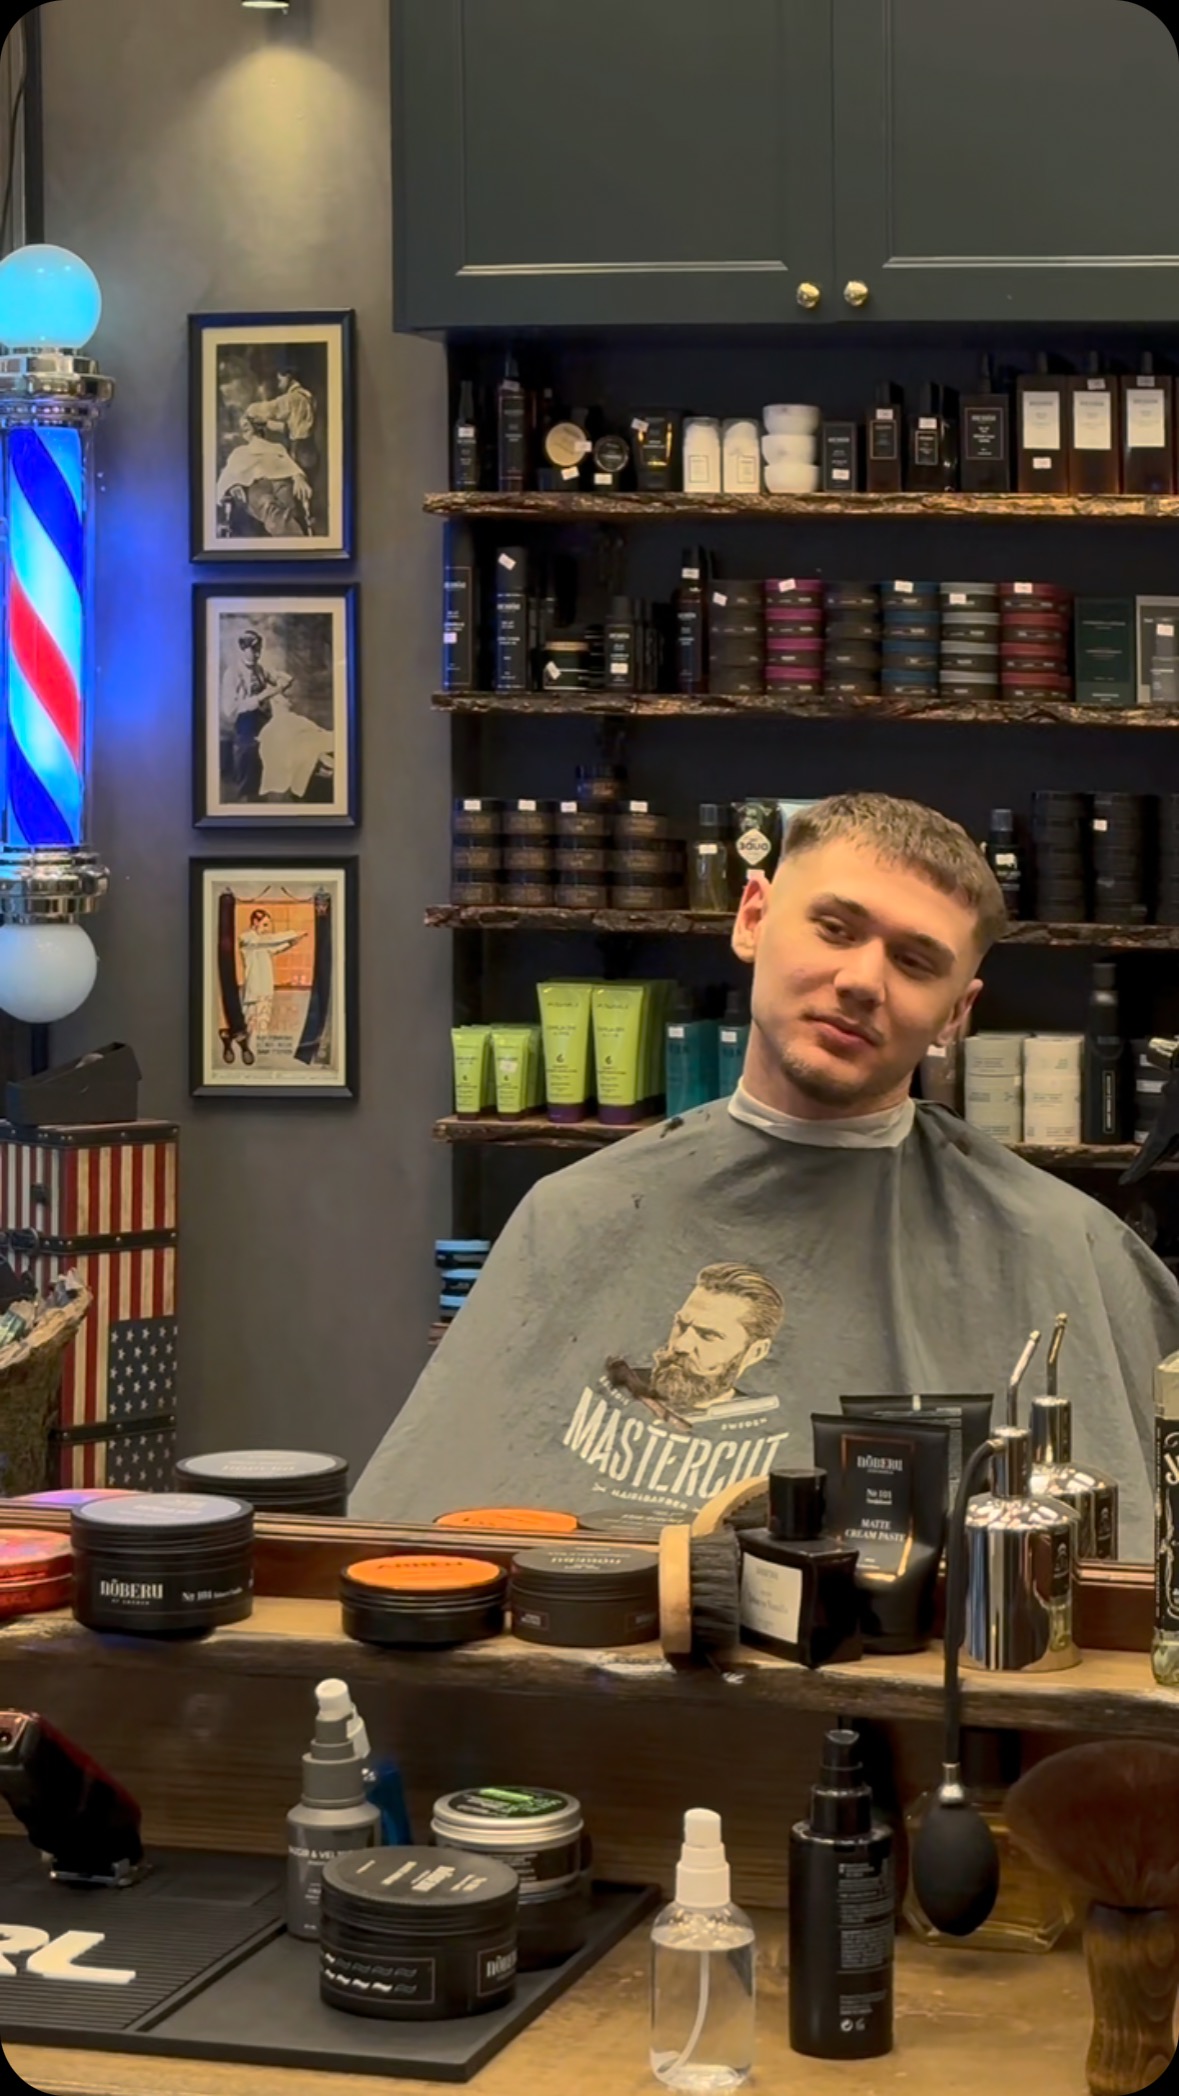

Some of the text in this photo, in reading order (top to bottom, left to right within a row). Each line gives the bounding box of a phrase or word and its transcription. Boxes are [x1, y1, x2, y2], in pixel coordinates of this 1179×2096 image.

[721, 1416, 768, 1431] SWEDEN
[562, 1385, 790, 1500] MASTERCUT
[861, 1518, 891, 1530] MATTE
[845, 1528, 906, 1543] CREAM PASTE
